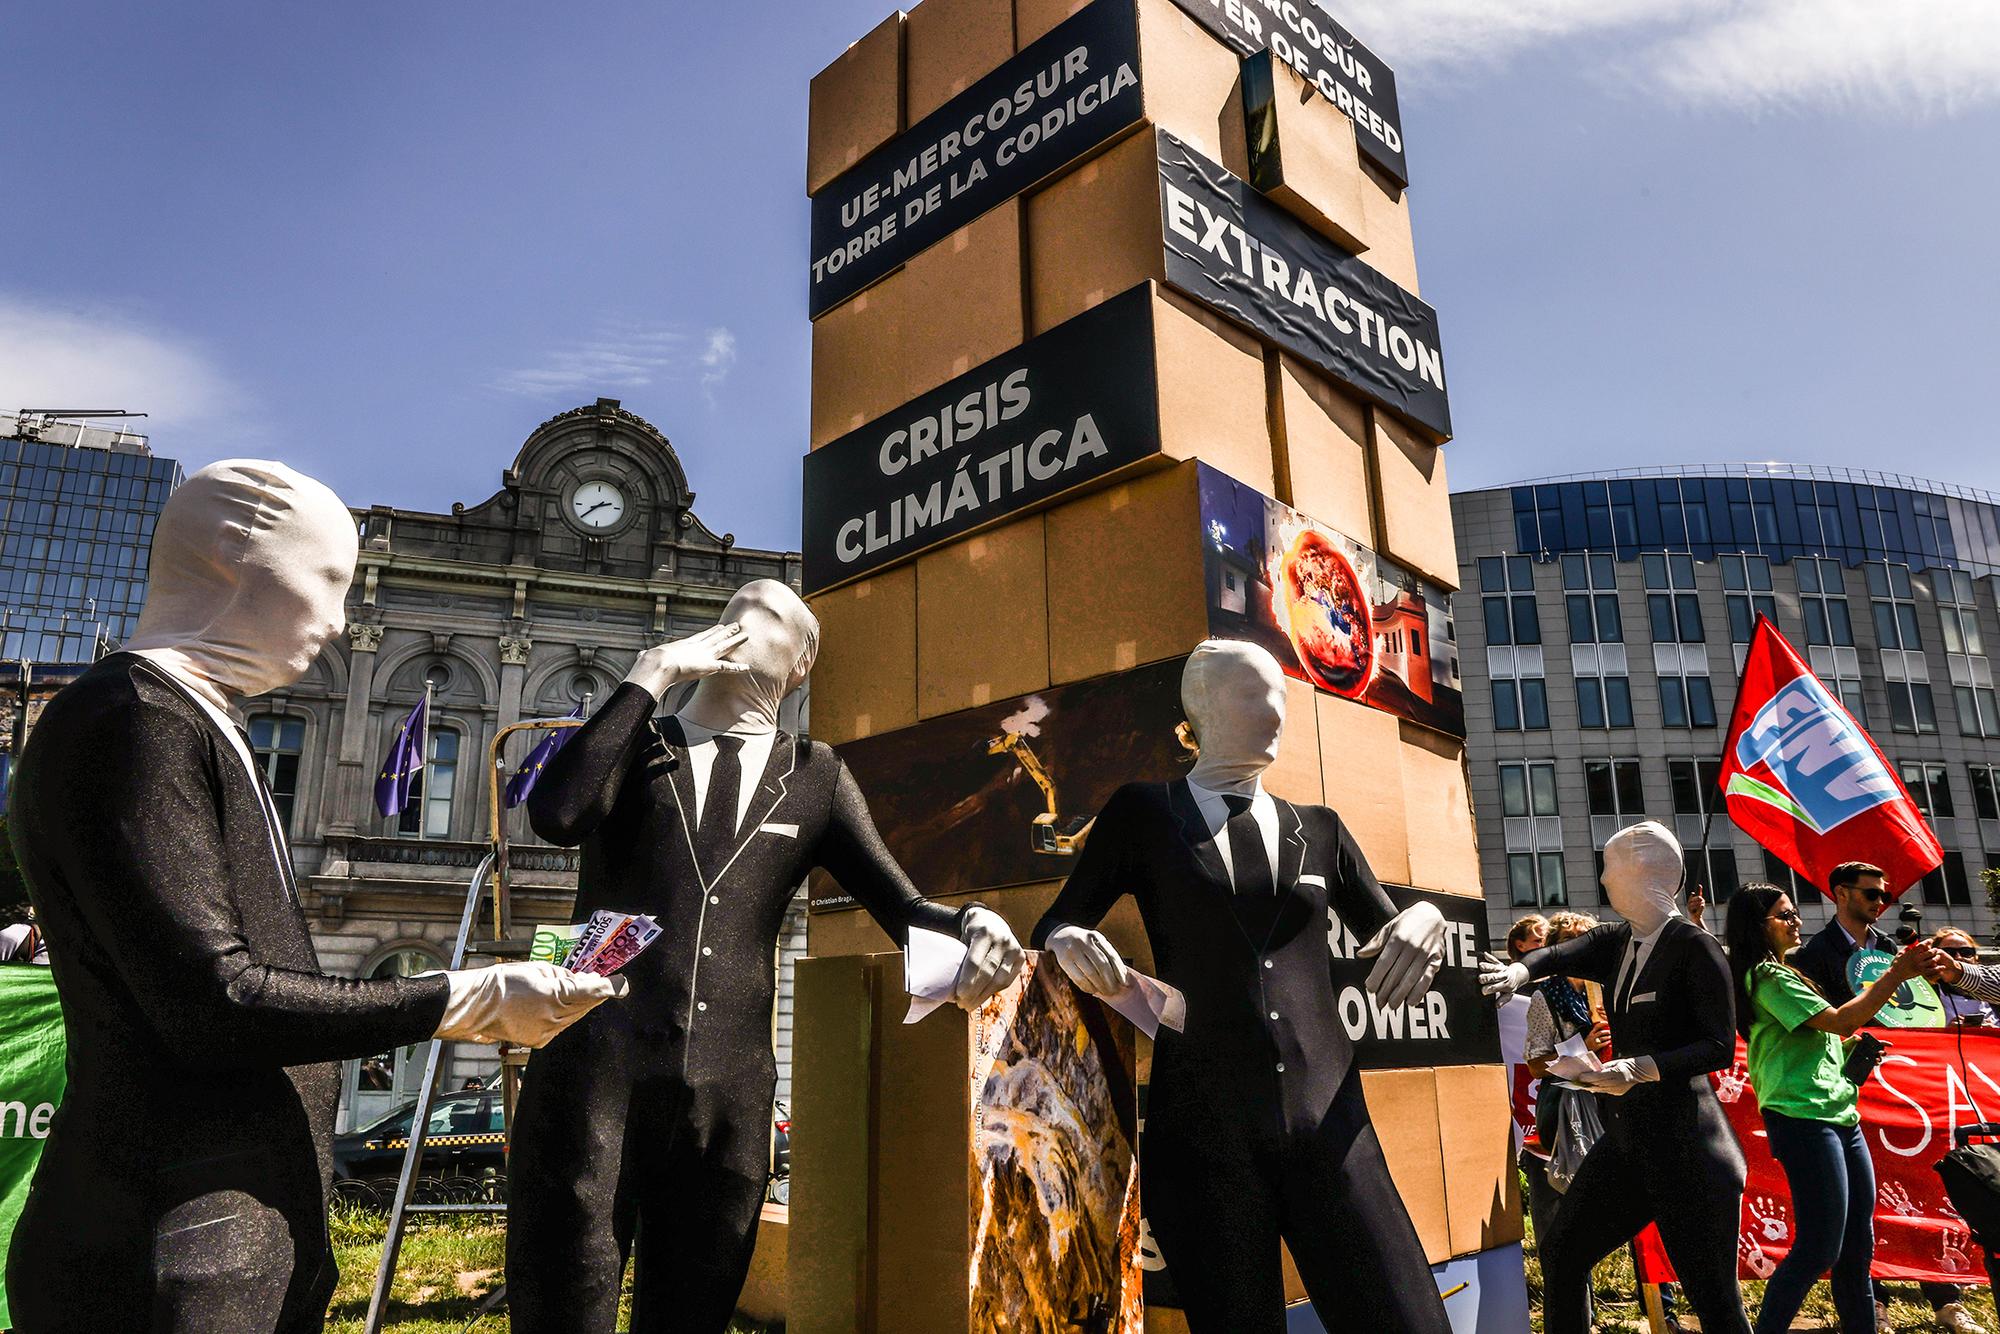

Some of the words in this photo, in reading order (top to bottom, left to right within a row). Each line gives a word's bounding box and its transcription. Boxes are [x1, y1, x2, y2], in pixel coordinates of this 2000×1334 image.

[1209, 0, 1265, 46] ER
[1270, 31, 1309, 75] OF
[1316, 68, 1402, 154] GREED
[1257, 0, 1374, 97] RCOSUR
[812, 212, 898, 285] TORRE
[904, 183, 943, 229] DE
[950, 157, 989, 201] LA
[995, 62, 1138, 167] CODICIA
[841, 46, 1089, 229] UE-MERCOSUR
[1165, 181, 1445, 392] EXTRACTION
[835, 412, 1109, 564] CLIMÁTICA
[878, 367, 1032, 477] CRISIS
[0, 1100, 56, 1139] ne
[1873, 1054, 2000, 1157] SA
